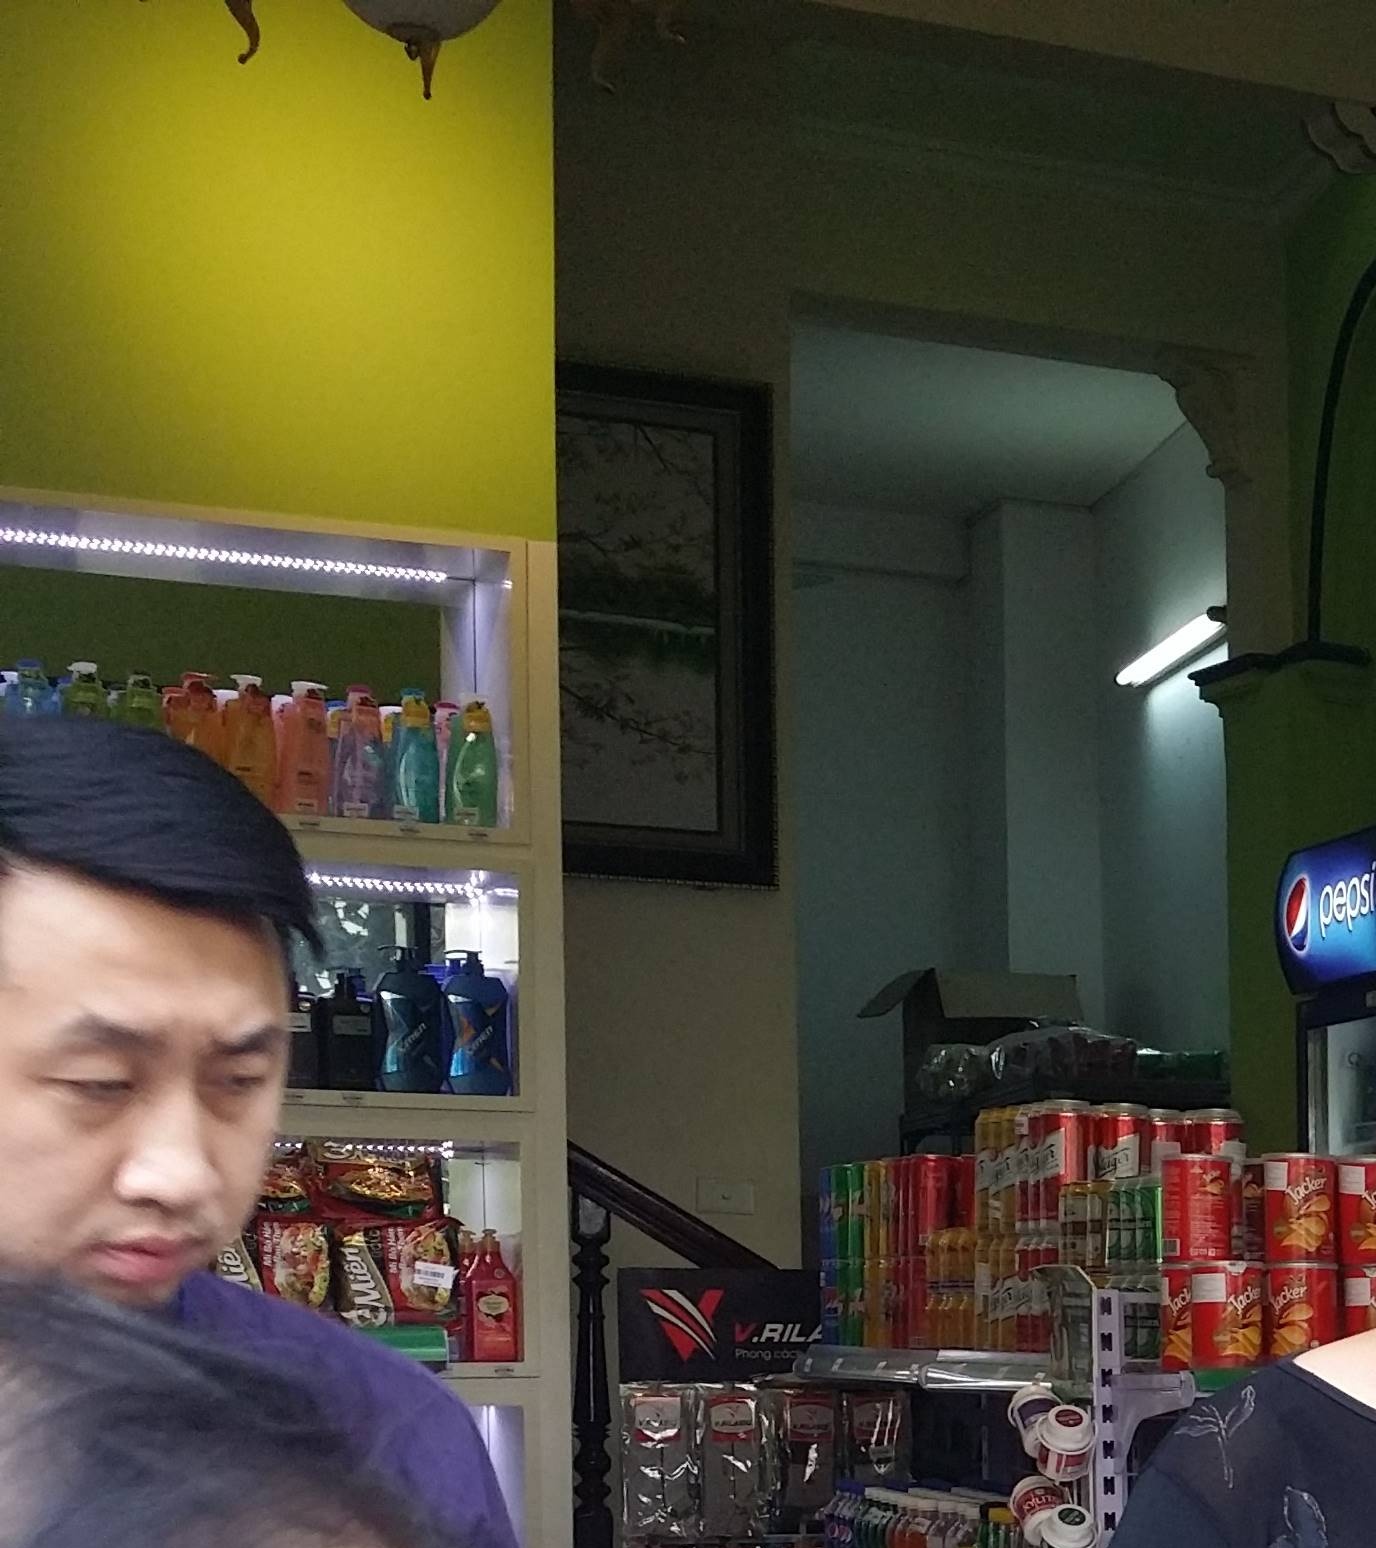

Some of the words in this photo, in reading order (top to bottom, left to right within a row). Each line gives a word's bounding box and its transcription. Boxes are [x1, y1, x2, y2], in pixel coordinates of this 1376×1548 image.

[1319, 861, 1376, 938] pepsi
[1285, 1176, 1327, 1206] Jacker
[1270, 1285, 1307, 1315] Jacker
